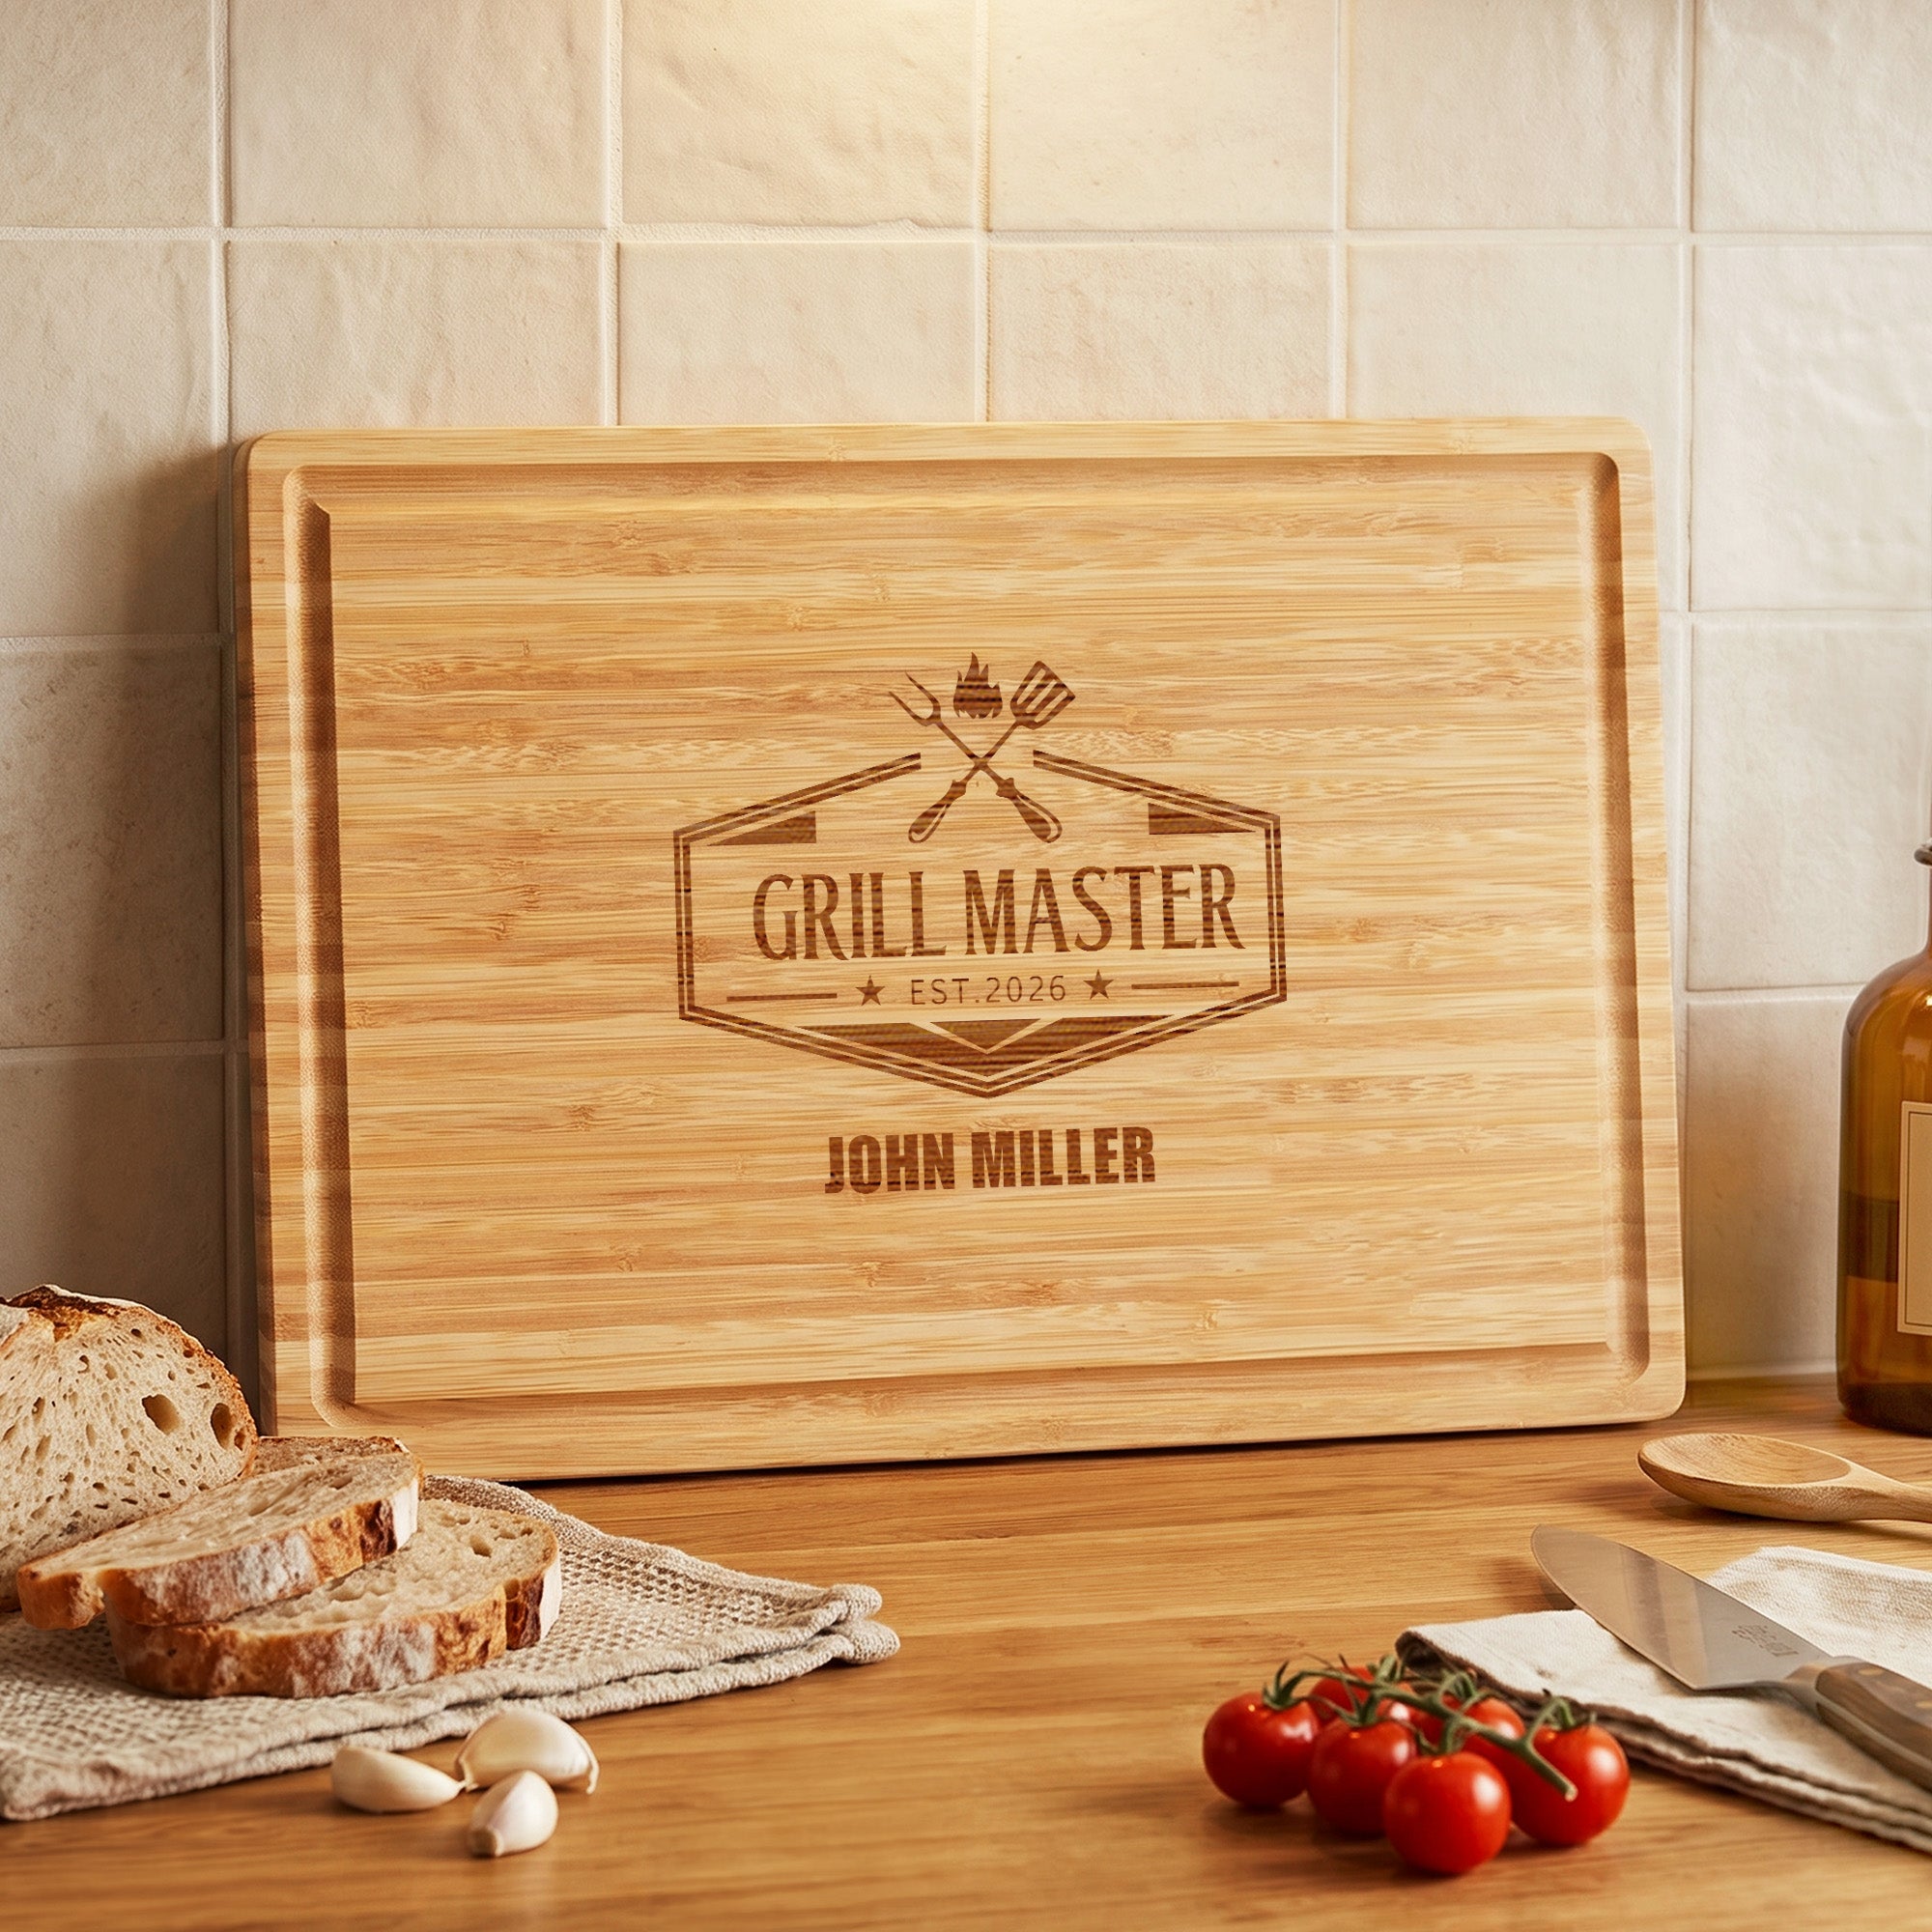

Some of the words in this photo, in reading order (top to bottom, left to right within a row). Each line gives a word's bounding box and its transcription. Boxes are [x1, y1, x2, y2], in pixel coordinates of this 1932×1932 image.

[753, 871, 947, 961] GRILL
[963, 864, 1246, 955] MASTER
[911, 975, 1066, 1007] EST.2026
[824, 1132, 955, 1195] JOHN
[971, 1125, 1156, 1190] MILLER
